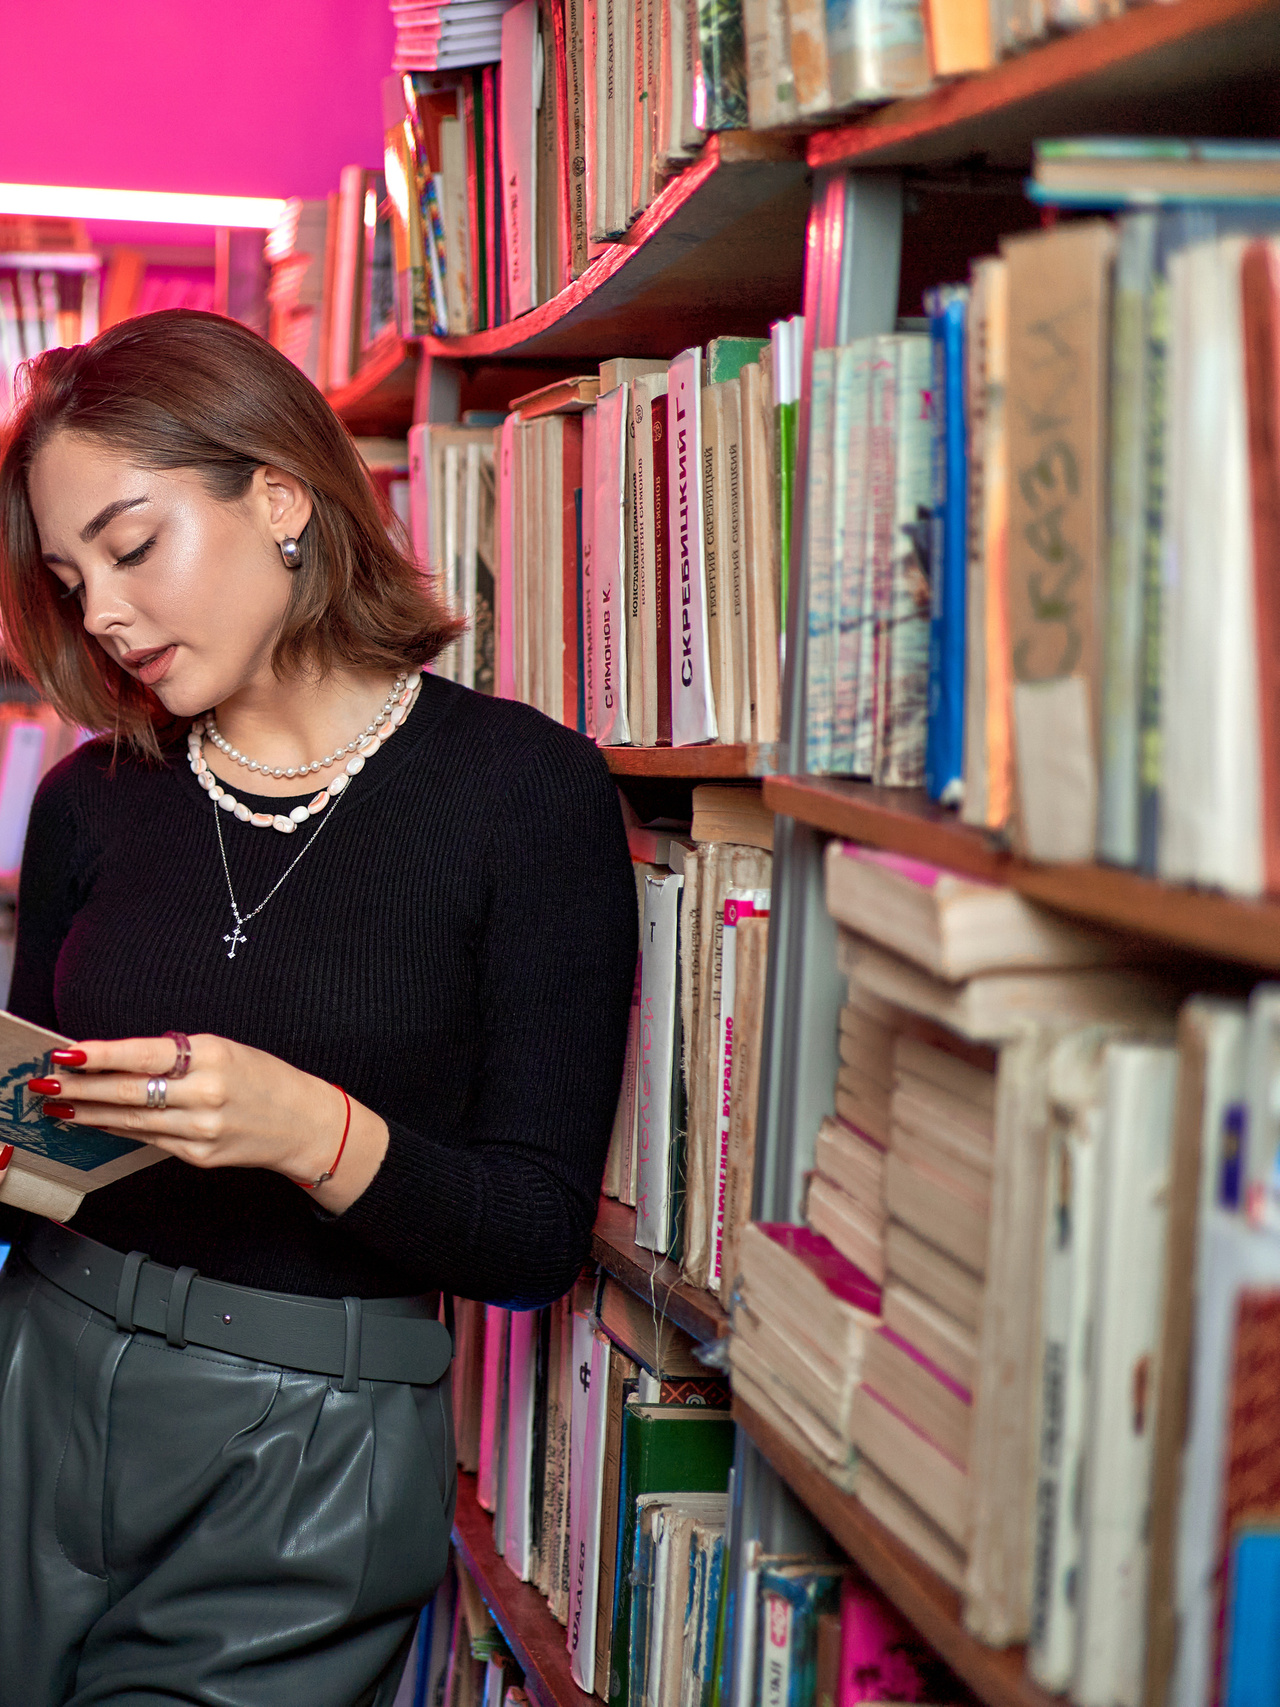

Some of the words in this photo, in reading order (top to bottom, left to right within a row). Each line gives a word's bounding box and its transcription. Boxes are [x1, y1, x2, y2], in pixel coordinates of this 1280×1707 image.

[674, 381, 687, 422] Г.
[703, 446, 716, 546] СКРЕБИЦКИЙ
[728, 444, 740, 544] СКРЕБИЦКИЙ
[602, 582, 612, 604] К.
[706, 550, 718, 618] ГЕОРГИЙ
[730, 549, 741, 617] ГЕОРГИЙ
[584, 588, 594, 725] СЕРАФИМОВИЧ
[689, 907, 701, 979] ТОЛСТОЙ
[712, 910, 725, 982] ТОЛСТОЙ
[714, 1130, 729, 1278] ПРИКЛЮЧЕНИЯ
